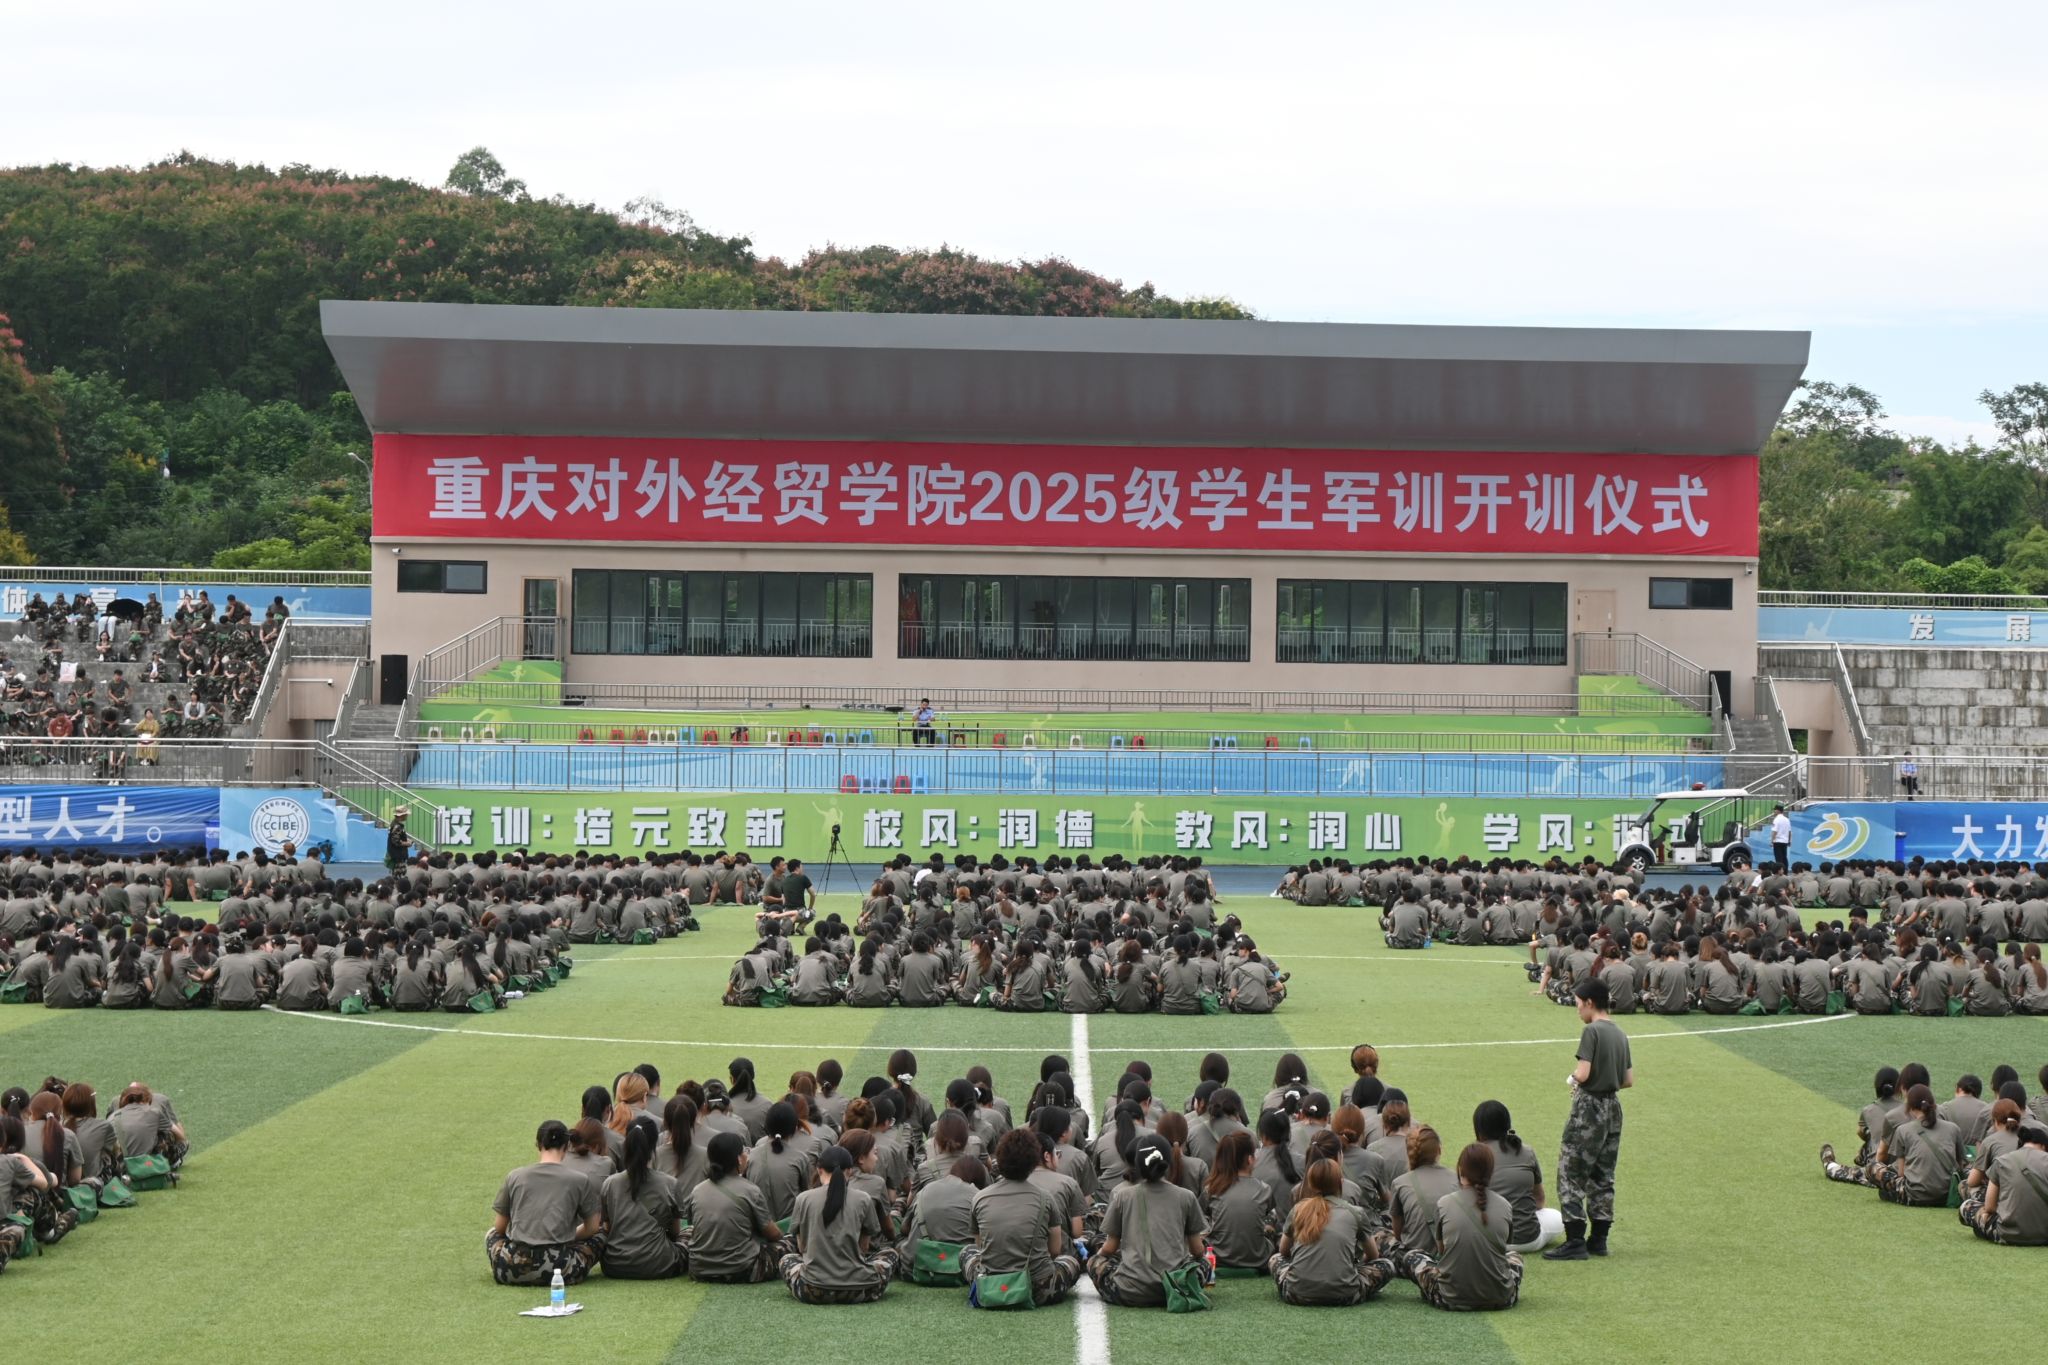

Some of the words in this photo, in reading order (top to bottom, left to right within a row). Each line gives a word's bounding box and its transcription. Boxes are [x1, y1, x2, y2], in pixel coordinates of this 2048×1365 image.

[427, 455, 1710, 538] 重庆对外经贸学院2025级学生军训开训仪式
[263, 821, 297, 831] CCIBE
[863, 808, 1094, 849] 校风：润德
[1175, 810, 1401, 850] 教风：润心
